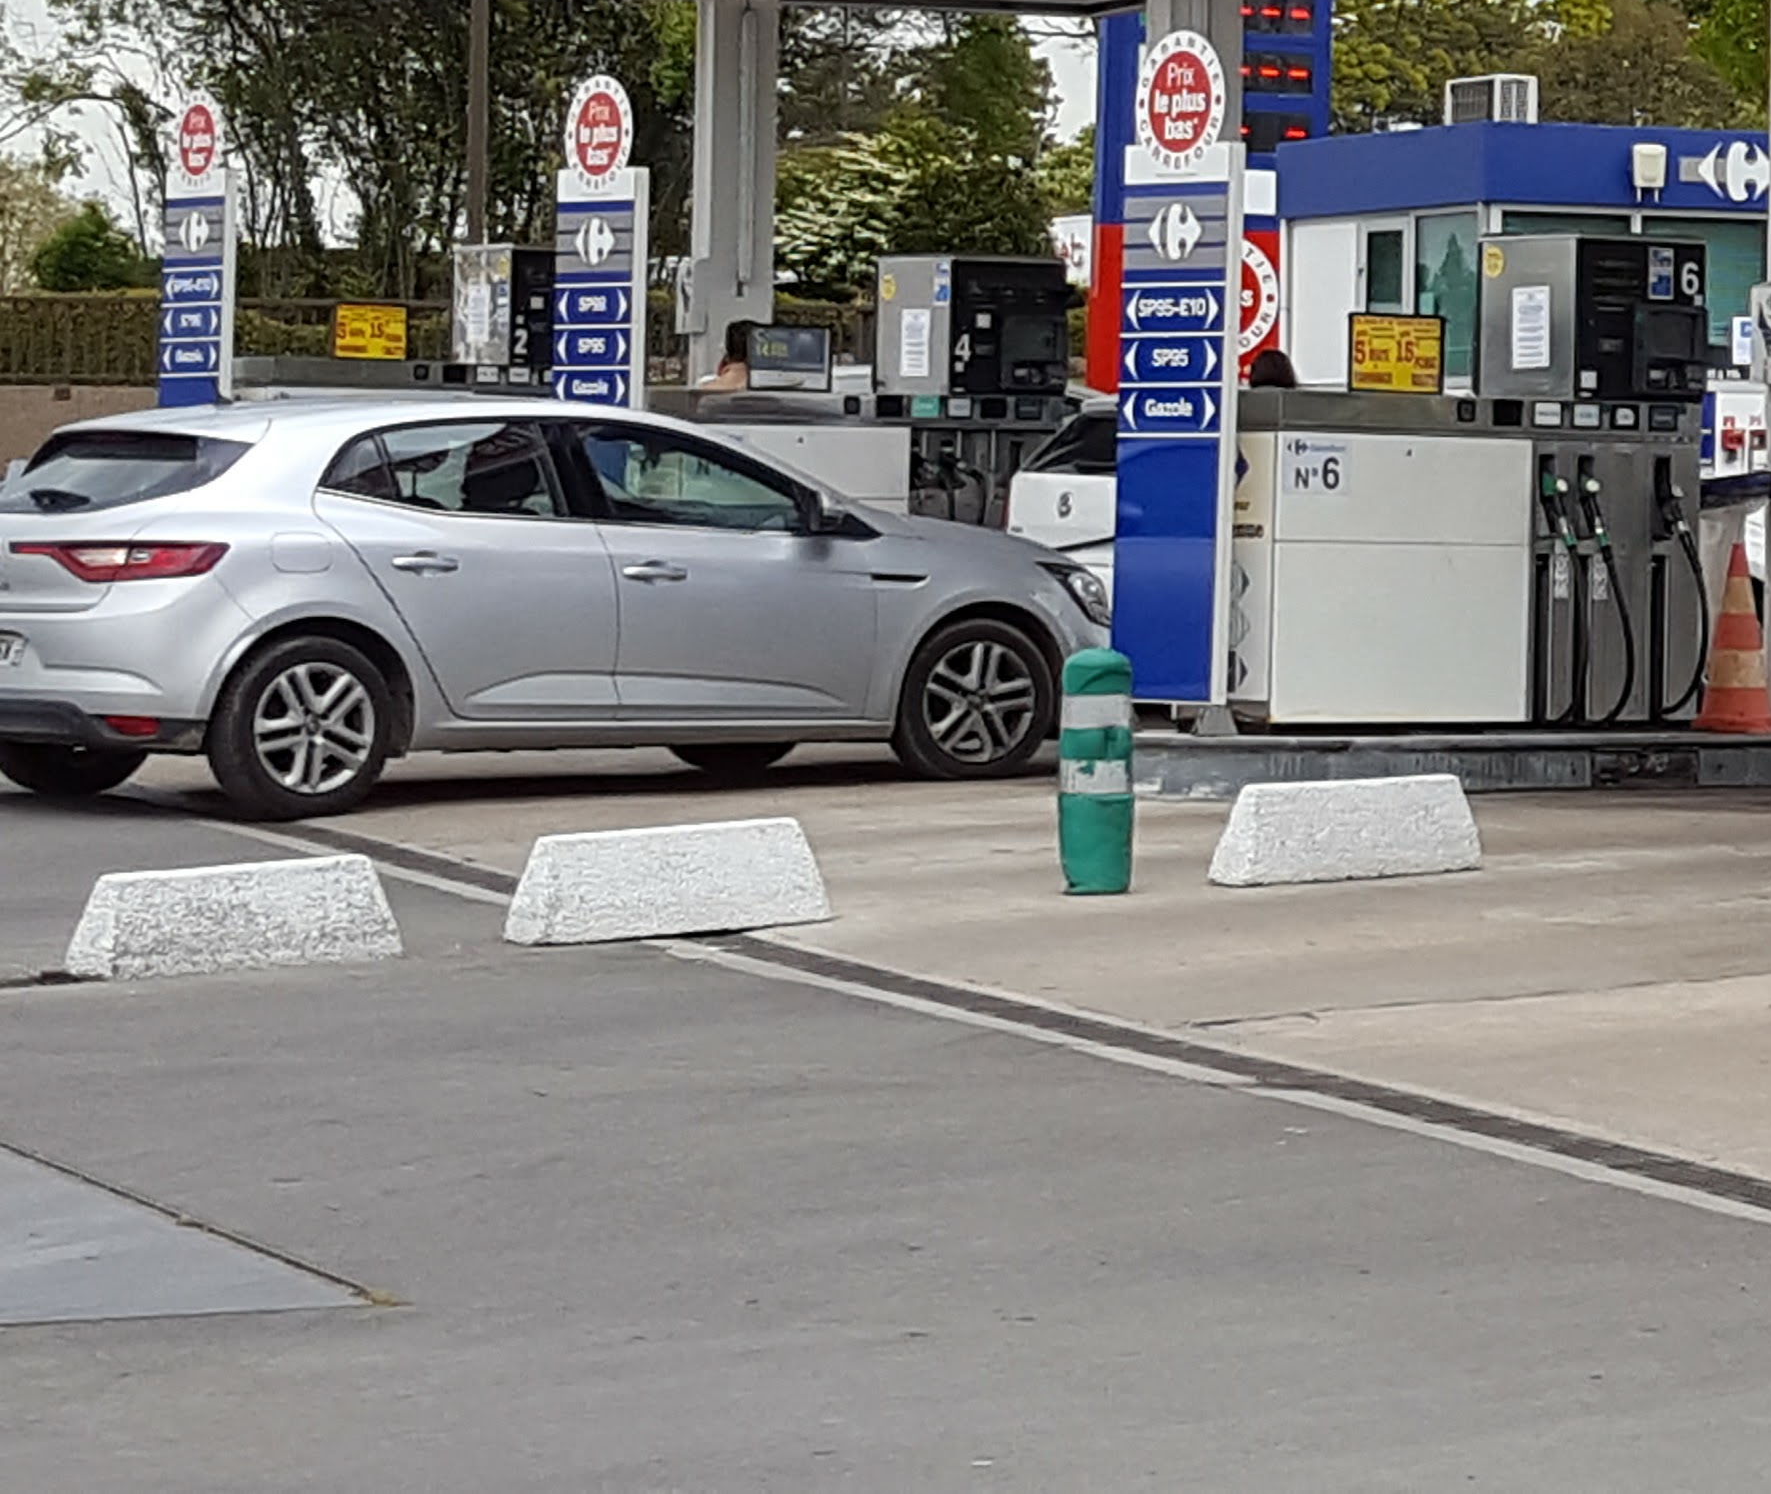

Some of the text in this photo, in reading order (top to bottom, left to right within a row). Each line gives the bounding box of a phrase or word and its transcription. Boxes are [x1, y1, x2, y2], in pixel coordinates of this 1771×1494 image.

[1166, 61, 1195, 88] Prix
[1154, 88, 1207, 118] le plus
[1681, 261, 1700, 295] 6
[513, 328, 529, 355] 2
[954, 333, 972, 362] 4
[1151, 348, 1189, 368] SP95
